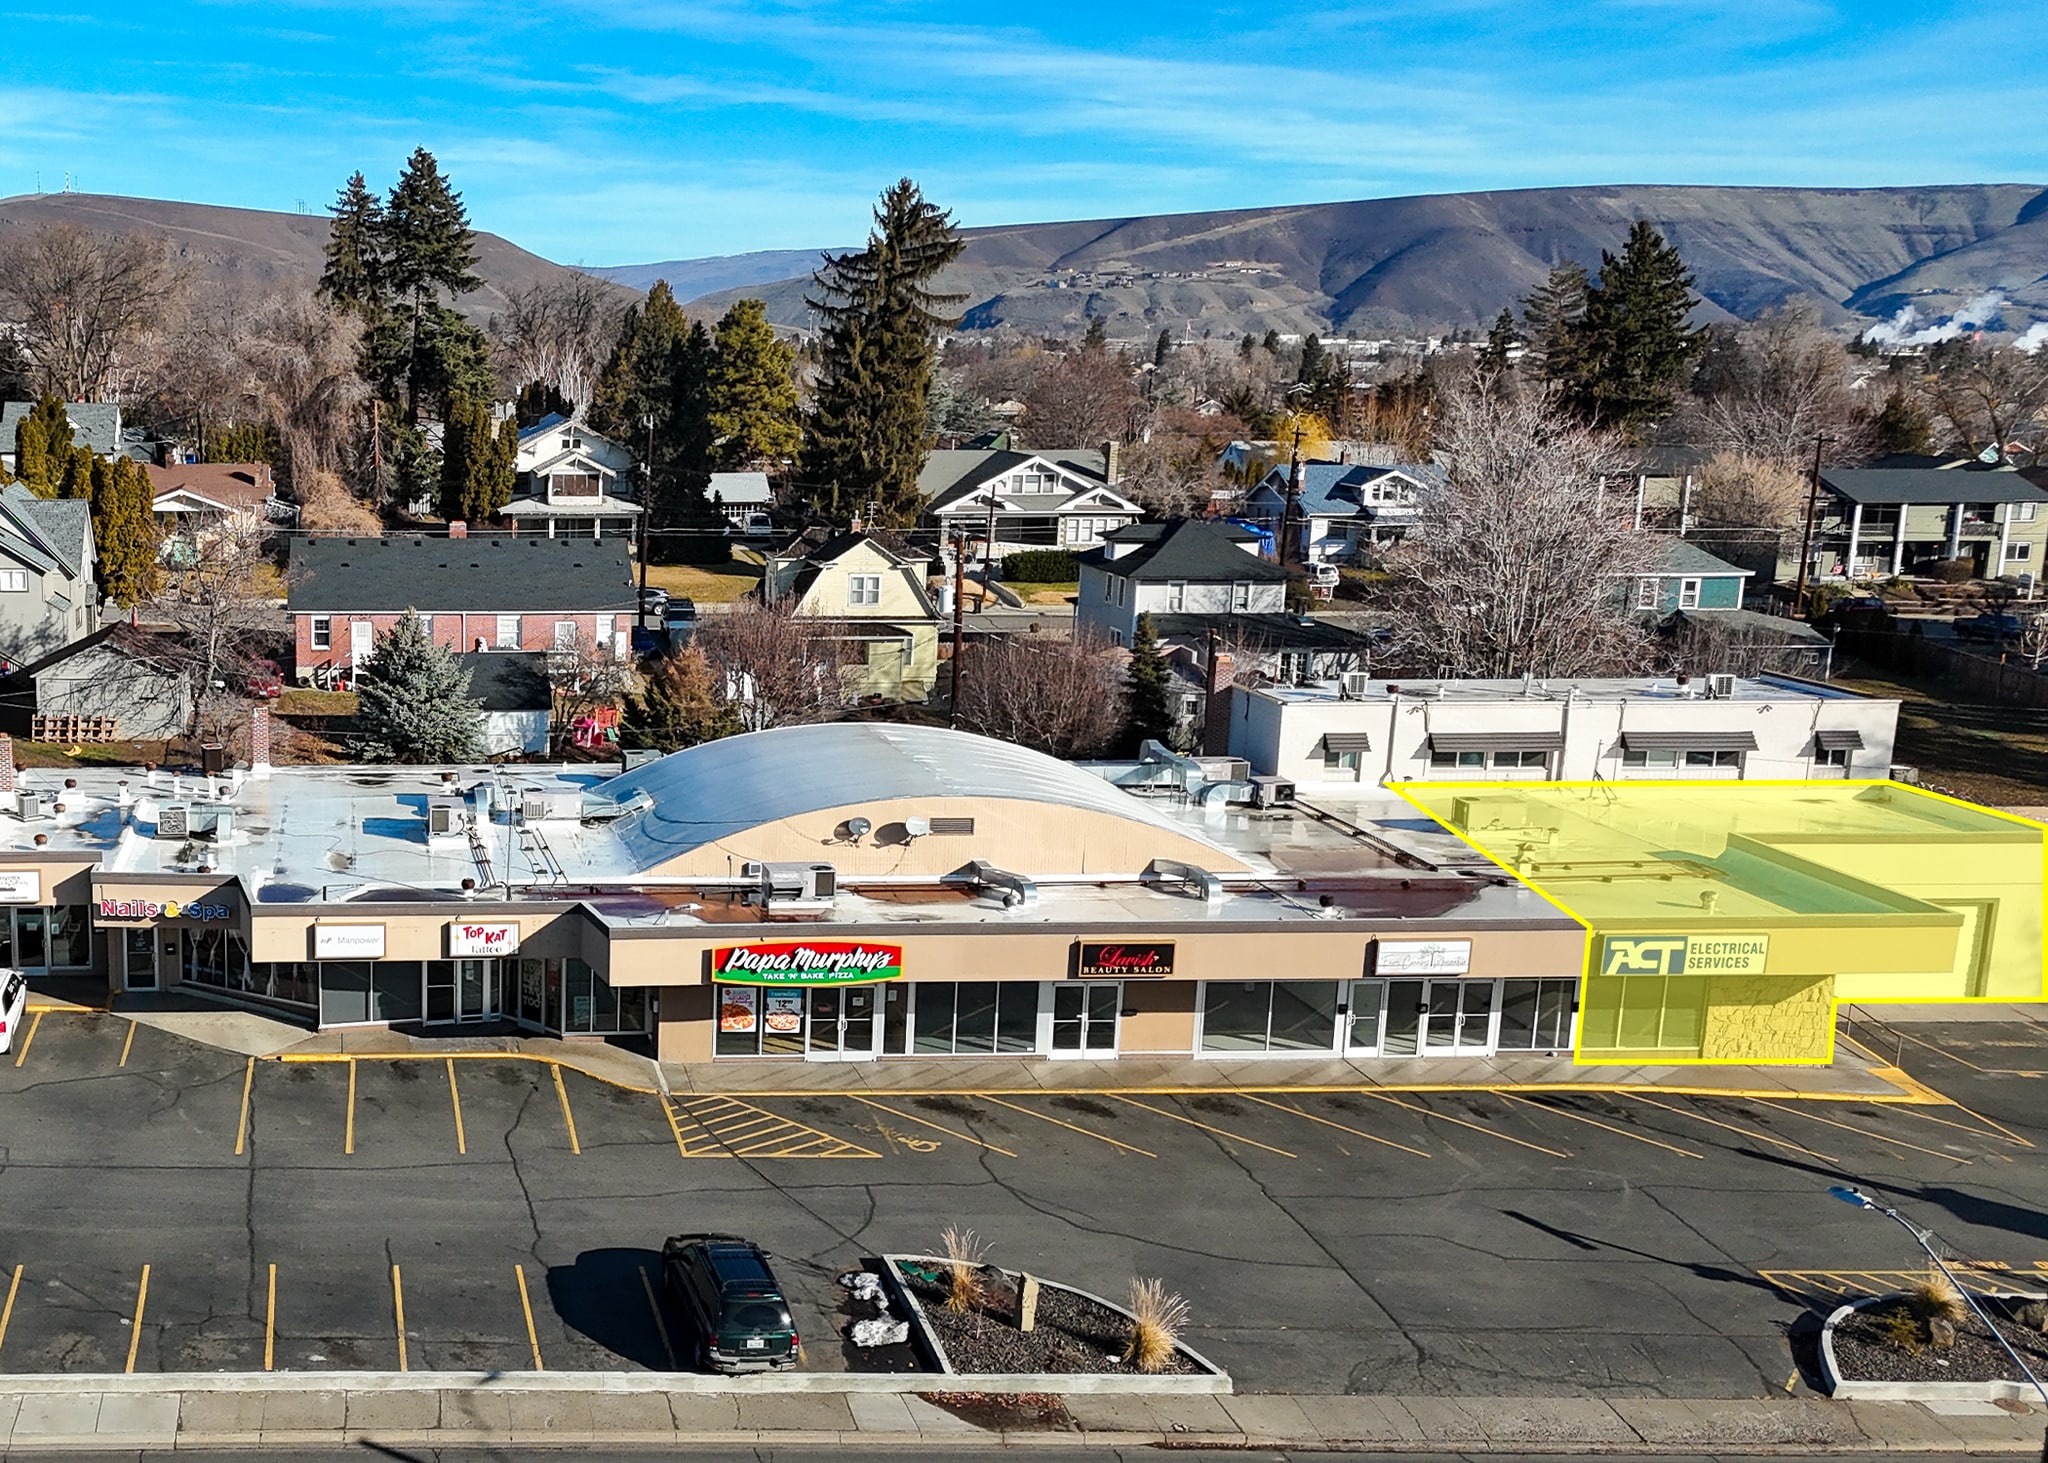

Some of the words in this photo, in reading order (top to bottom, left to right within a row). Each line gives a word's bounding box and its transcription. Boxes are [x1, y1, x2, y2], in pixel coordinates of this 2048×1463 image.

[101, 900, 158, 918] Nails
[164, 900, 182, 918] &
[188, 902, 230, 922] Spa
[337, 936, 379, 945] Manpower
[463, 926, 484, 940] TOP
[485, 929, 508, 944] KAT
[725, 947, 791, 974] Papa
[792, 946, 894, 973] Murphy's
[1096, 946, 1156, 967] Lavish
[1606, 941, 1685, 975] ACT
[1690, 942, 1765, 955] ELECTRICAL
[1688, 956, 1750, 969] SERVICES
[1083, 966, 1128, 974] BEAUTY
[1133, 966, 1172, 974] SALON
